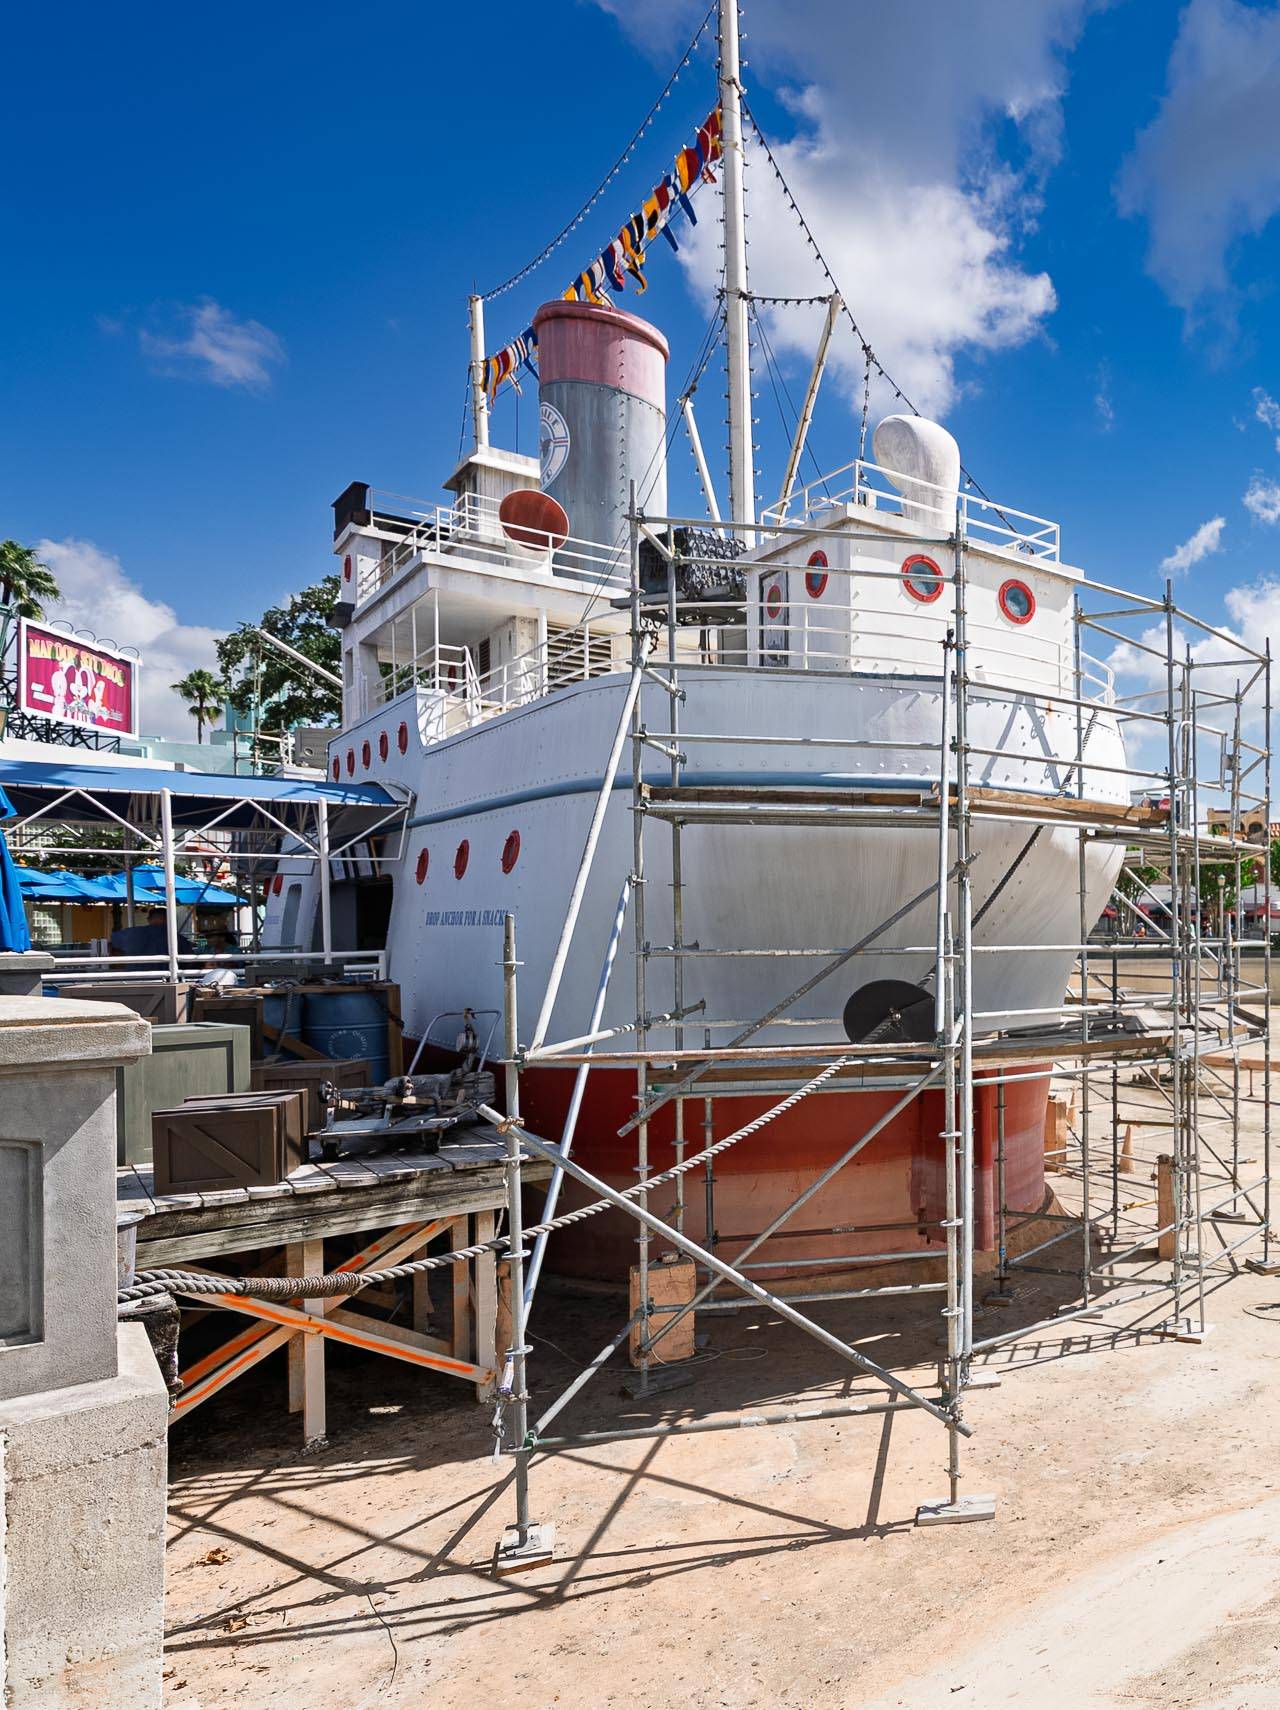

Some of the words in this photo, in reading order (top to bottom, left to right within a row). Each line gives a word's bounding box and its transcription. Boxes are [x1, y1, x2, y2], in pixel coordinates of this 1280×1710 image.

[426, 911, 440, 926] DROP
[440, 911, 463, 926] ANCHOR
[464, 911, 476, 926] FOR
